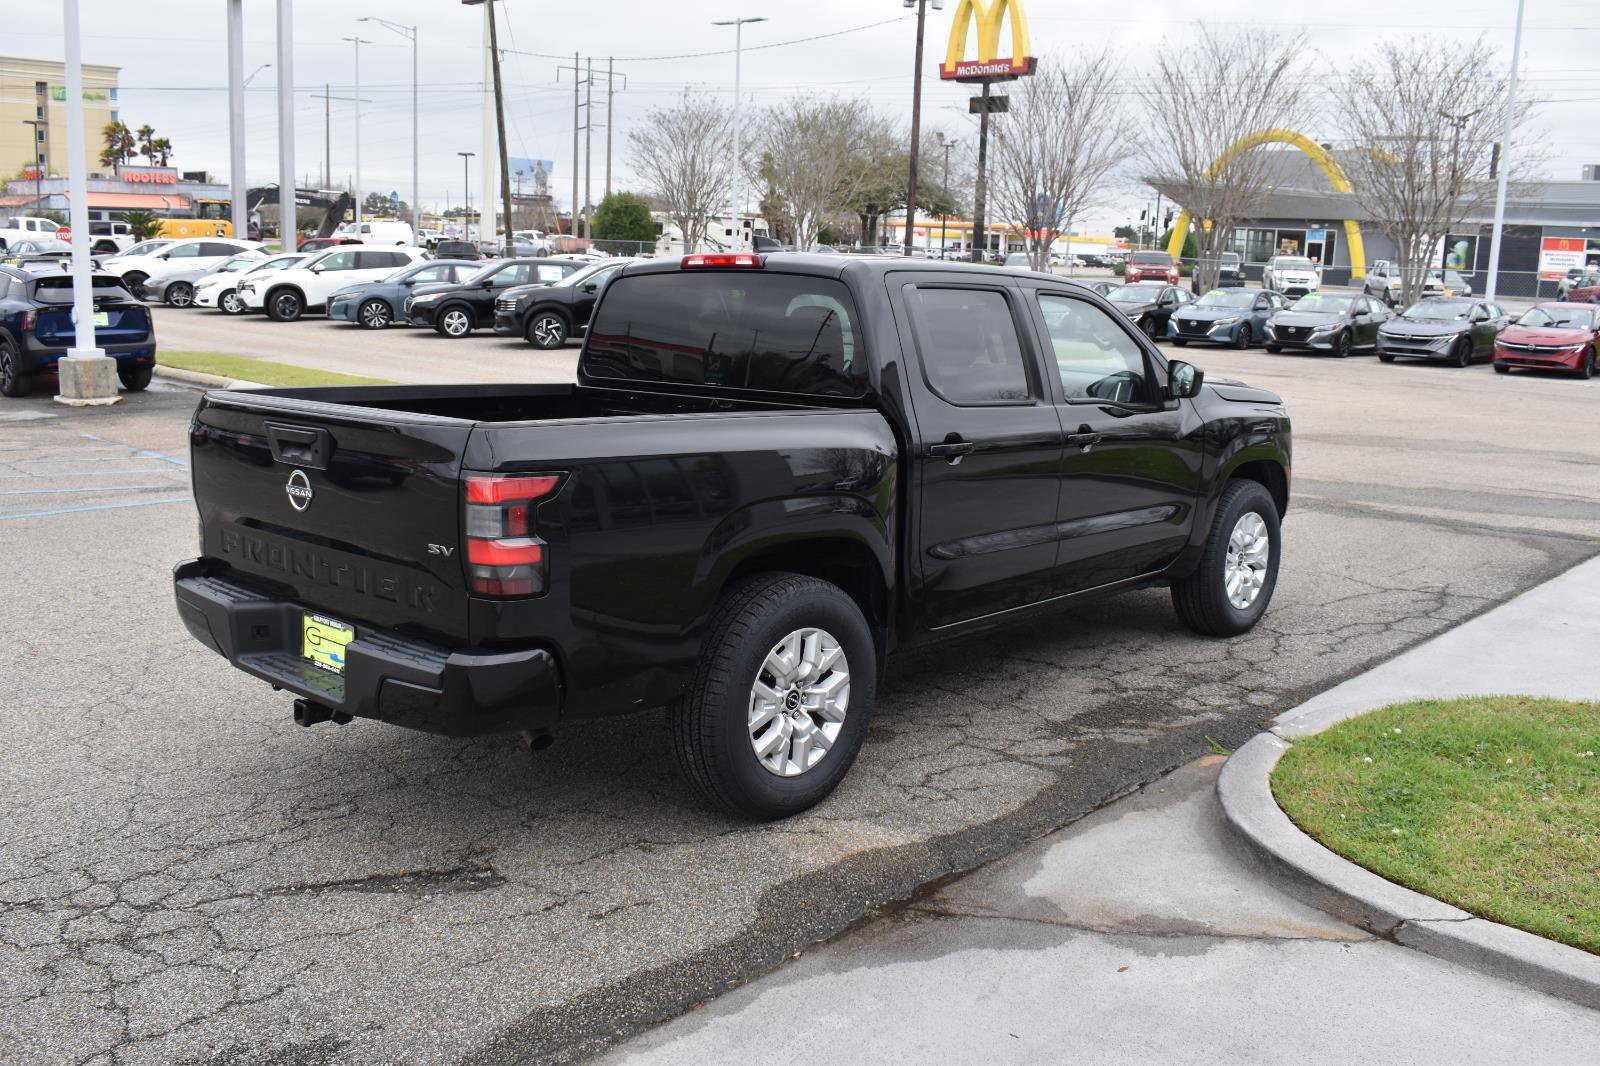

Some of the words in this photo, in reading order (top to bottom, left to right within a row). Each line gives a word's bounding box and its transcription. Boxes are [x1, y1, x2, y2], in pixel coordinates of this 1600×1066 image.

[956, 63, 1010, 76] McDonald's
[124, 171, 176, 184] HOOTERS
[427, 543, 454, 557] SV
[221, 528, 434, 612] FRONTIER
